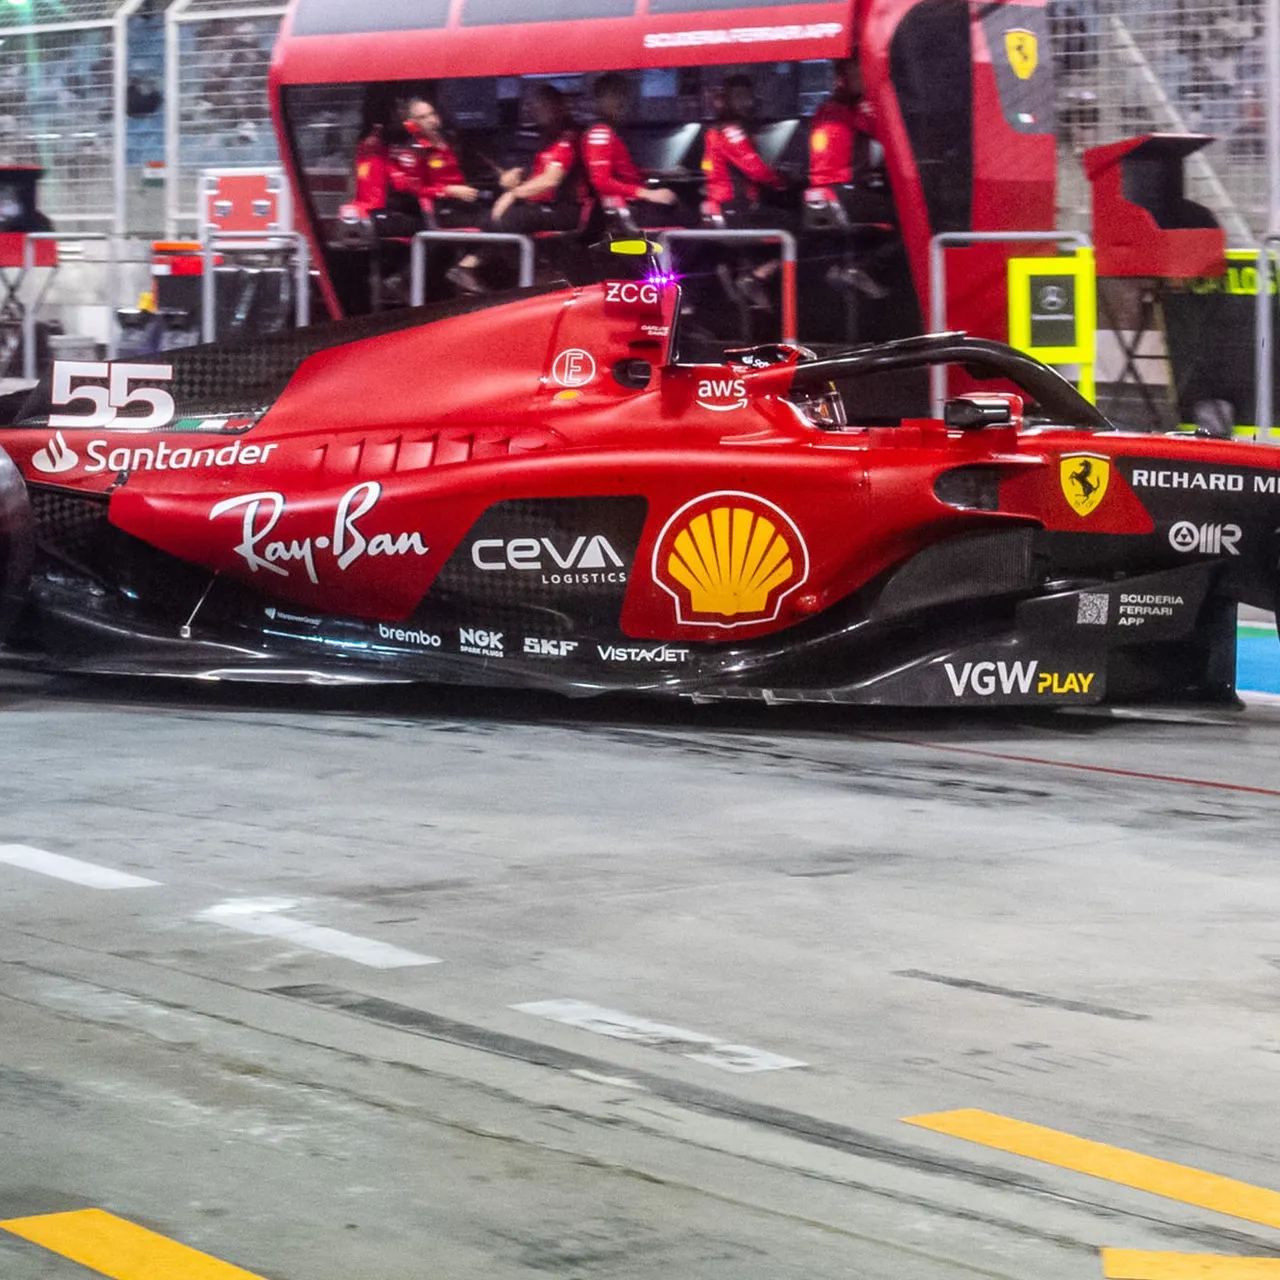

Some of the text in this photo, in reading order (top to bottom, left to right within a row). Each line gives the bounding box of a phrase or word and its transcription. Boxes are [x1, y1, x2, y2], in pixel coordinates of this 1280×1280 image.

[48, 360, 176, 430] 55
[698, 379, 746, 397] aws
[84, 439, 278, 472] Santander
[1132, 469, 1244, 493] RICHARD
[541, 572, 627, 584] LOGISTICS
[1119, 593, 1184, 605] SCUDERIA
[1119, 605, 1173, 615] FERRARI
[1118, 616, 1145, 626] APP
[378, 623, 442, 647] brembo
[459, 627, 504, 650] NGK
[523, 637, 579, 657] SKF
[944, 660, 1095, 697] VGW PLAY
